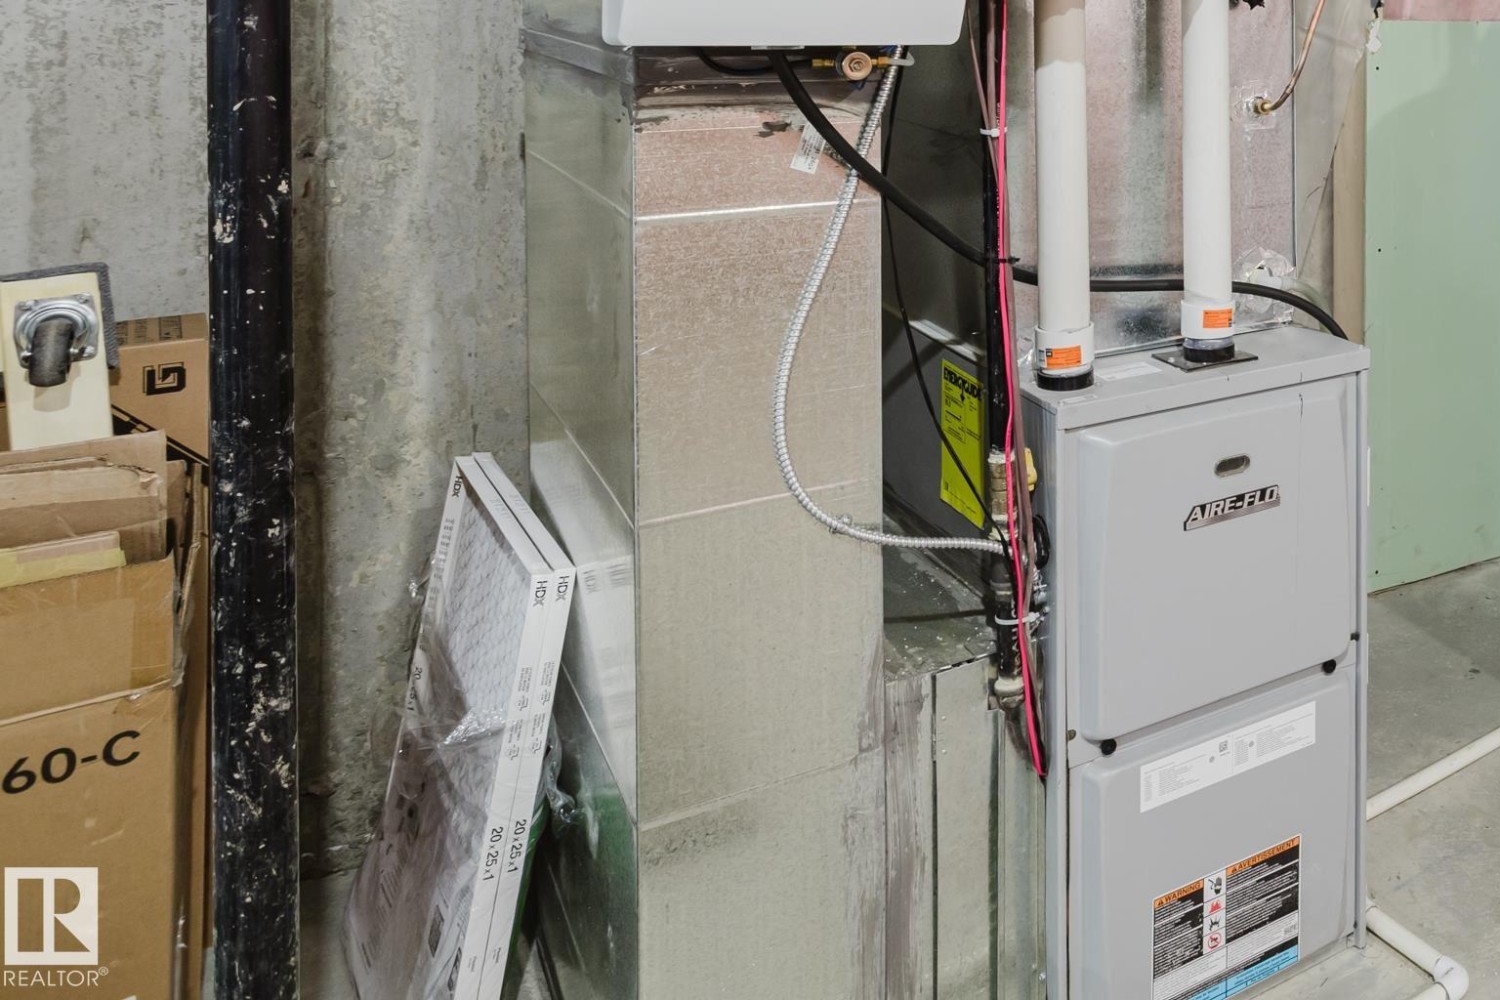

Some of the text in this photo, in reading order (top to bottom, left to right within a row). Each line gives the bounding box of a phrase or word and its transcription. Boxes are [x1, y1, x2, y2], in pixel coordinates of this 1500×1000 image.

[452, 475, 463, 498] HDX
[1188, 486, 1278, 525] AIRE-FLO
[533, 580, 548, 607] HDX
[555, 575, 569, 601] HDX
[1, 730, 141, 794] 60-C
[1236, 839, 1296, 871] AVERTISSEMENT
[1164, 882, 1201, 903] WARNING
